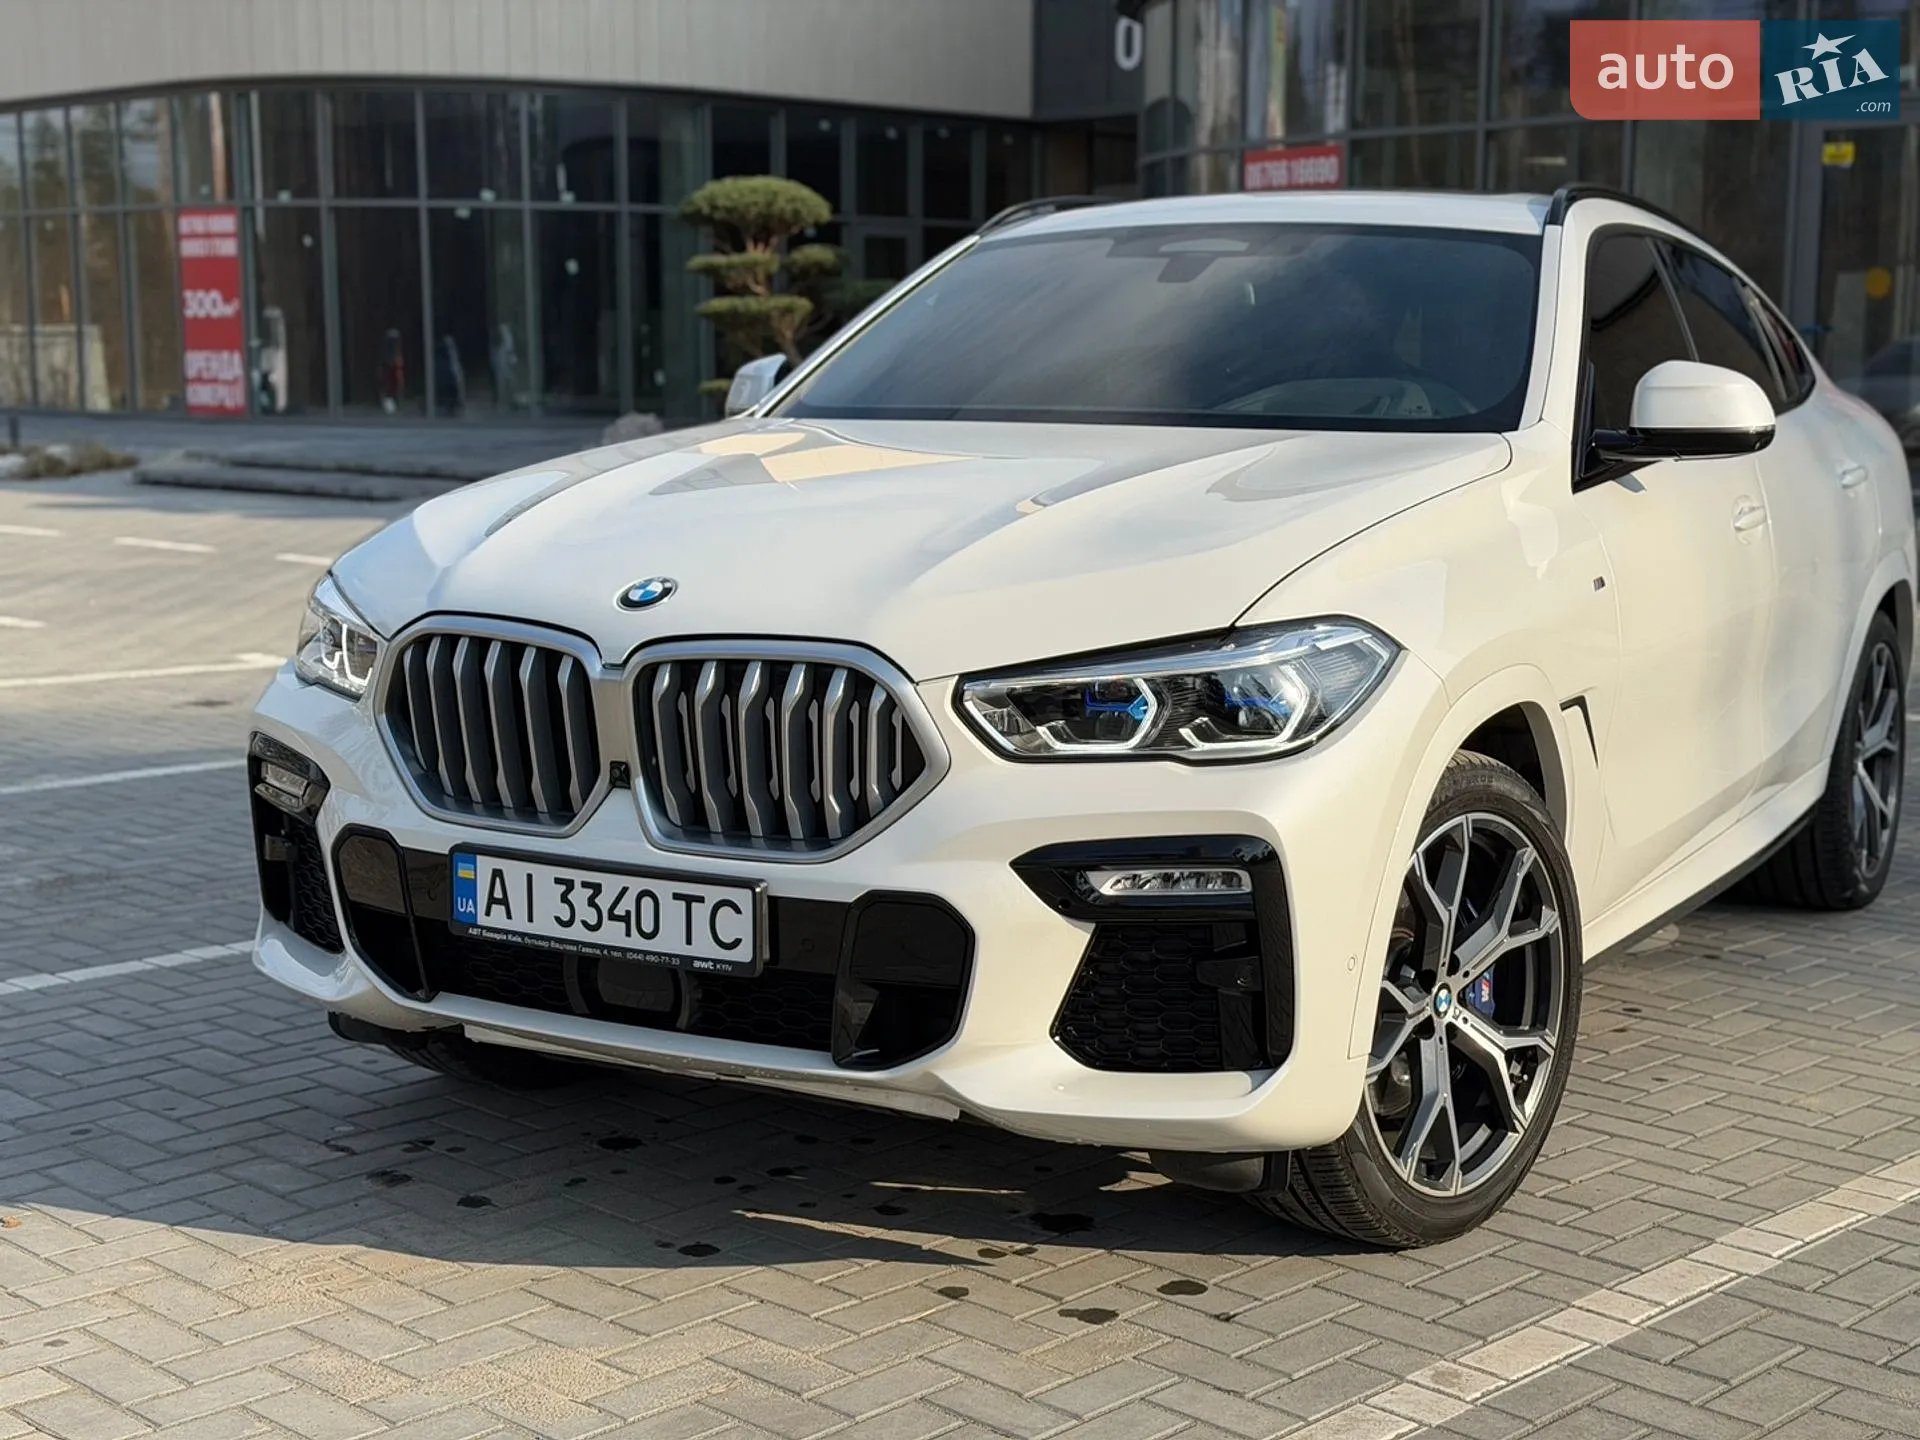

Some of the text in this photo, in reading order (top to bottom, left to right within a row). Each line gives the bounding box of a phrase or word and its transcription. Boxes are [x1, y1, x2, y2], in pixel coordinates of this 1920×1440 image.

[458, 897, 476, 914] UA
[484, 868, 743, 951] AI 3340 TC
[693, 960, 714, 970] awt
